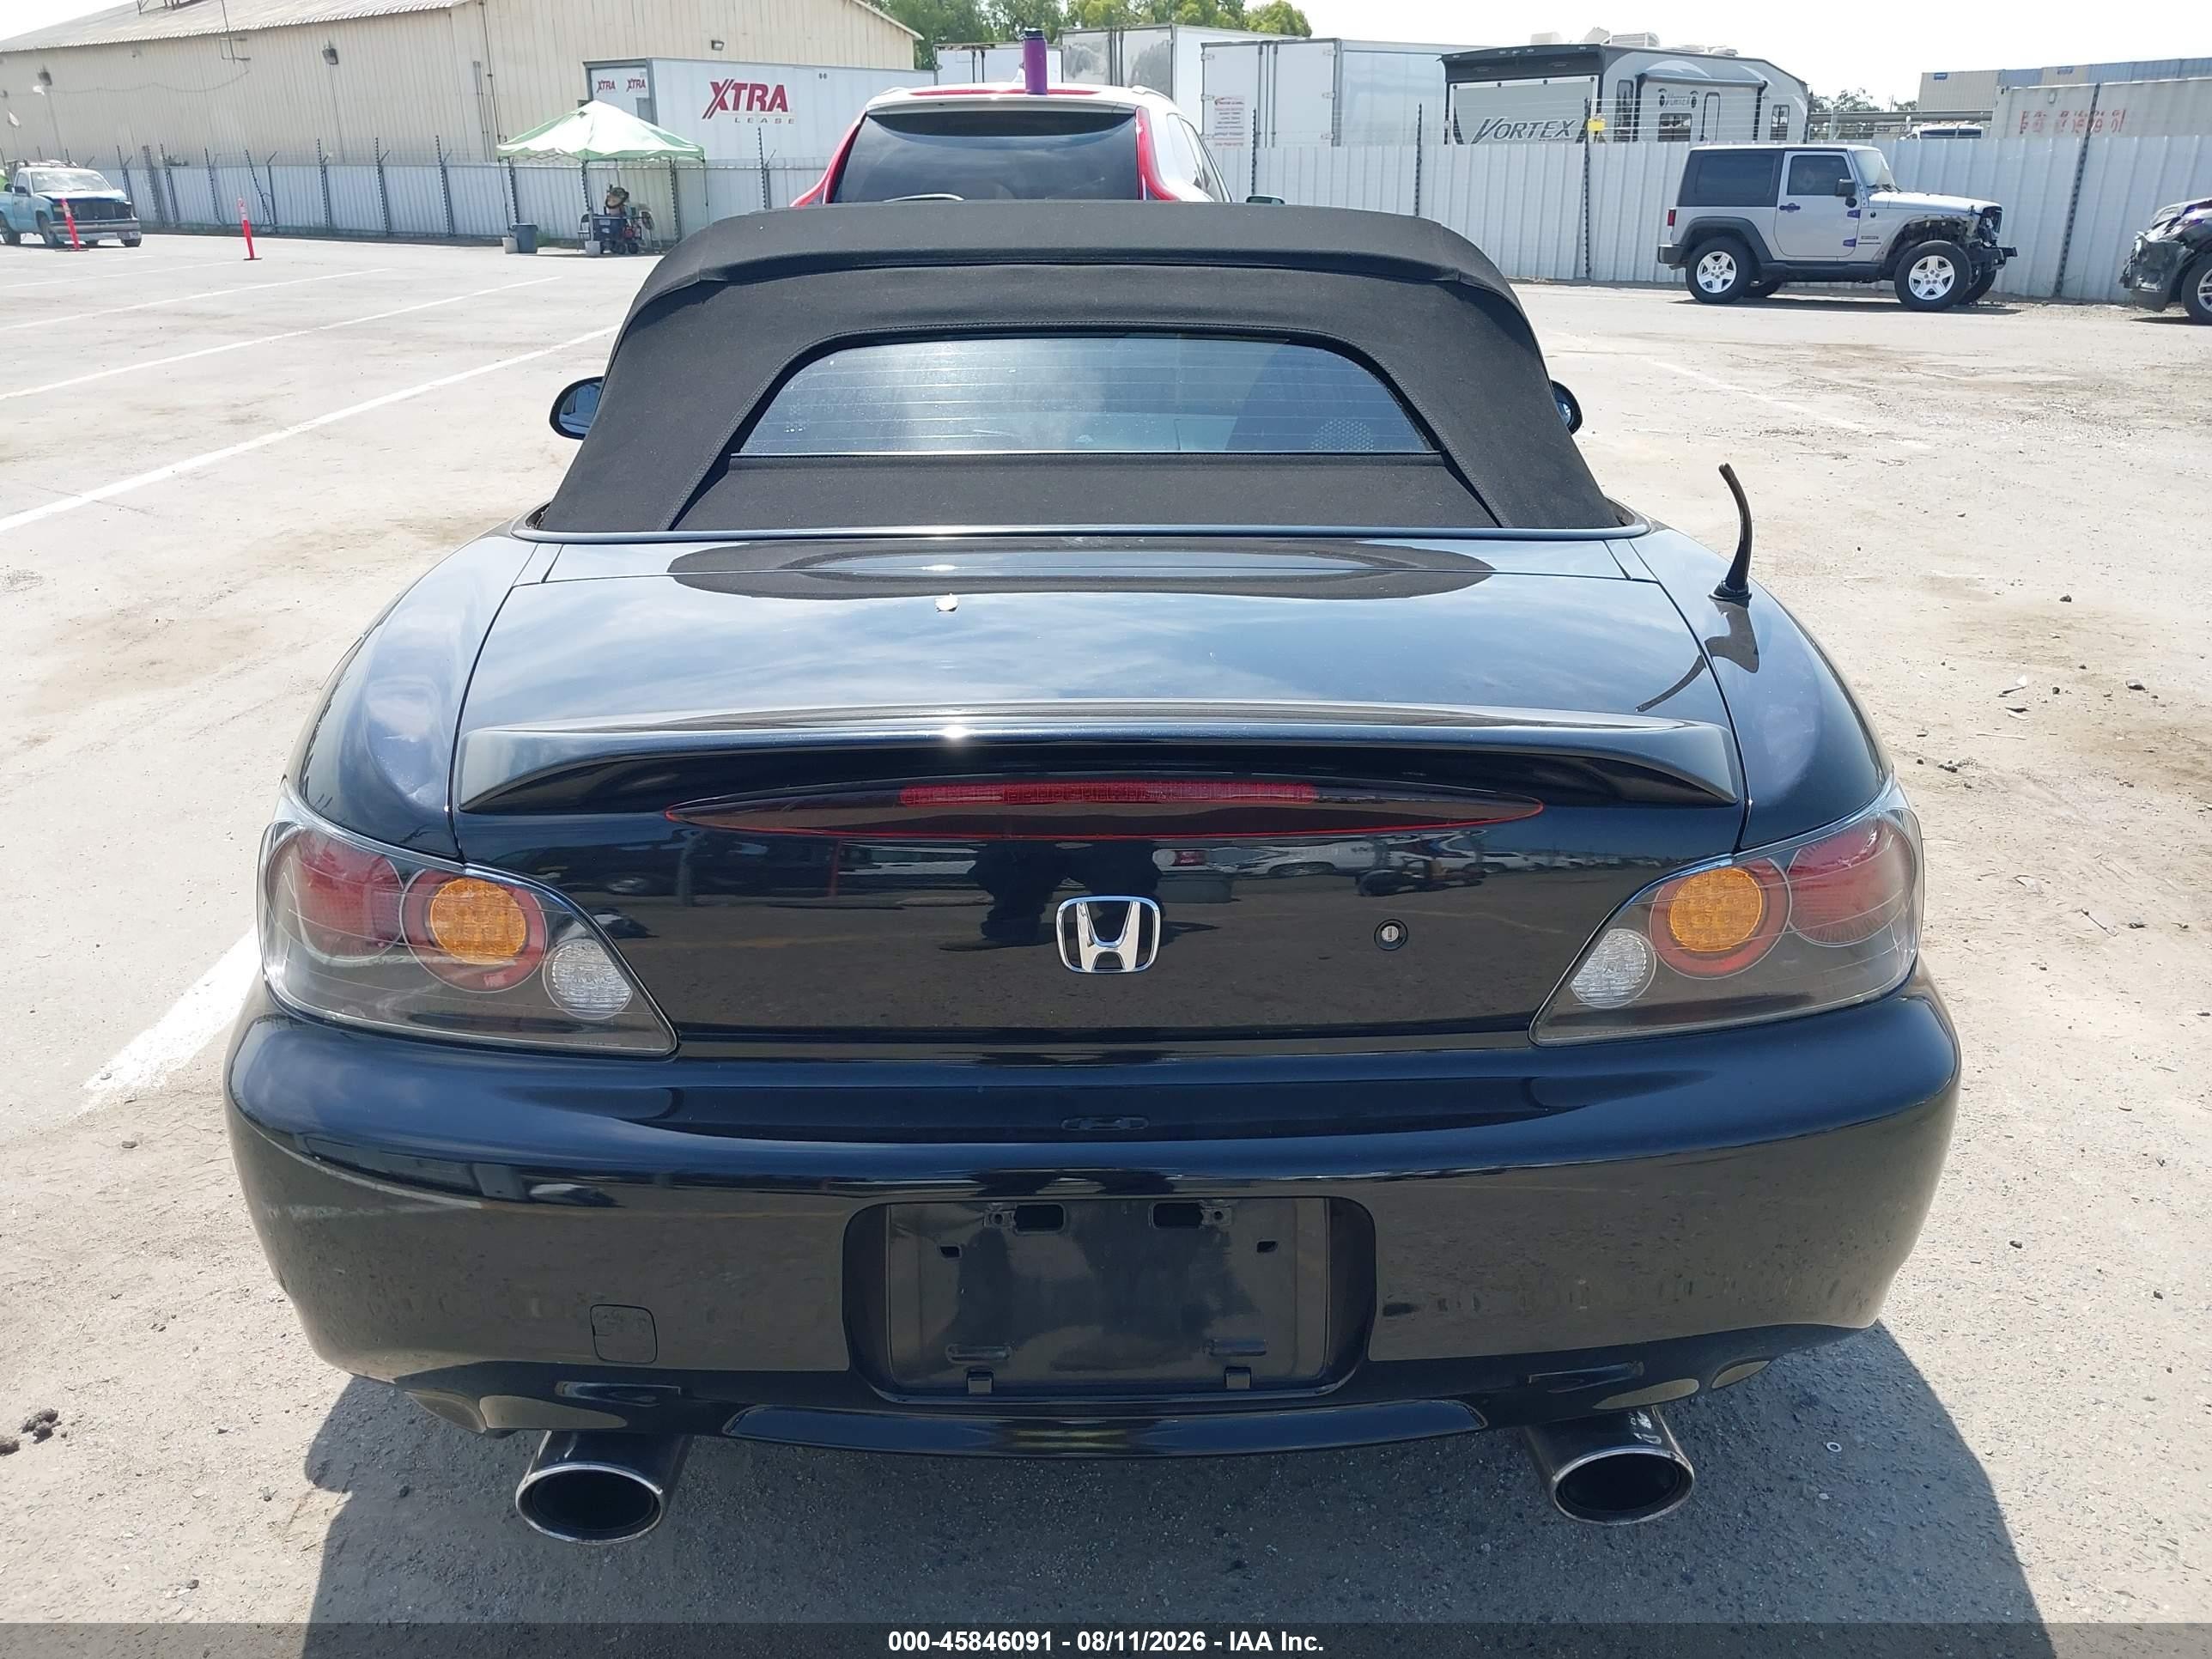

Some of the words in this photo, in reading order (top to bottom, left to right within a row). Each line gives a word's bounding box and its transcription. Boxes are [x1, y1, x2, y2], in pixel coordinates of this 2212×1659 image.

[597, 79, 616, 94] XTRA
[626, 77, 647, 93] XTRA
[702, 78, 789, 119] XTRA
[1471, 117, 1577, 144] VORTEX
